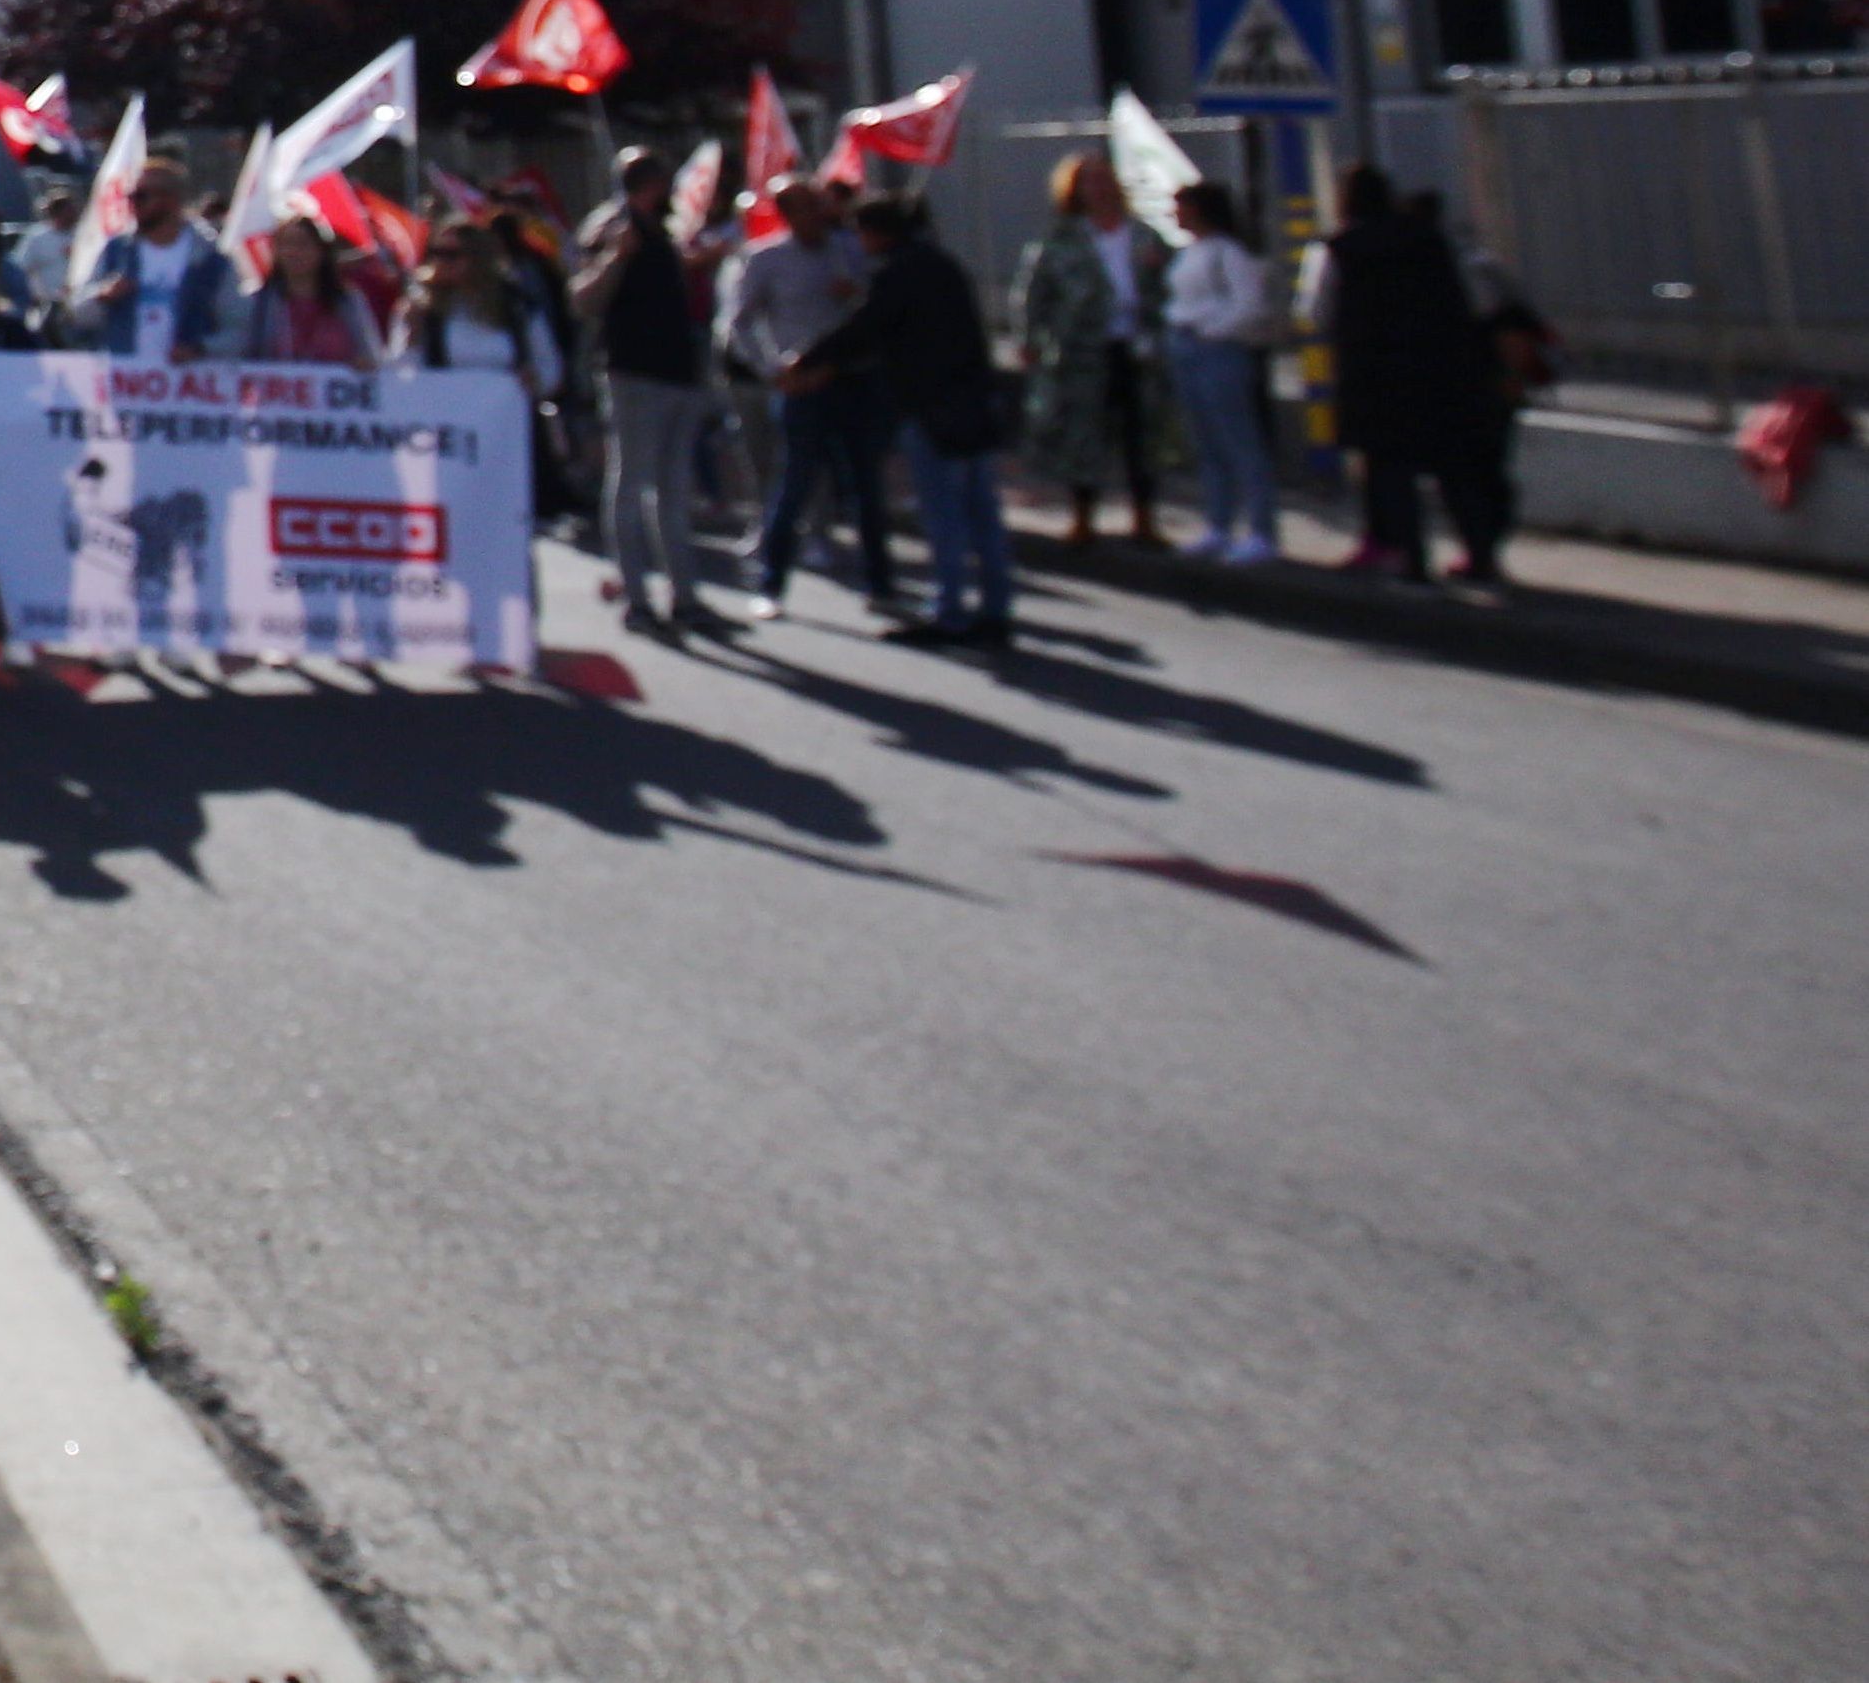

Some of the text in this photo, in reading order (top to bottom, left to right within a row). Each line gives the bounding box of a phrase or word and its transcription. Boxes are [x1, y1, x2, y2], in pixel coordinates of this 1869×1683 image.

[175, 371, 226, 404] AL
[324, 376, 381, 412] DE
[276, 507, 439, 553] CCOO
